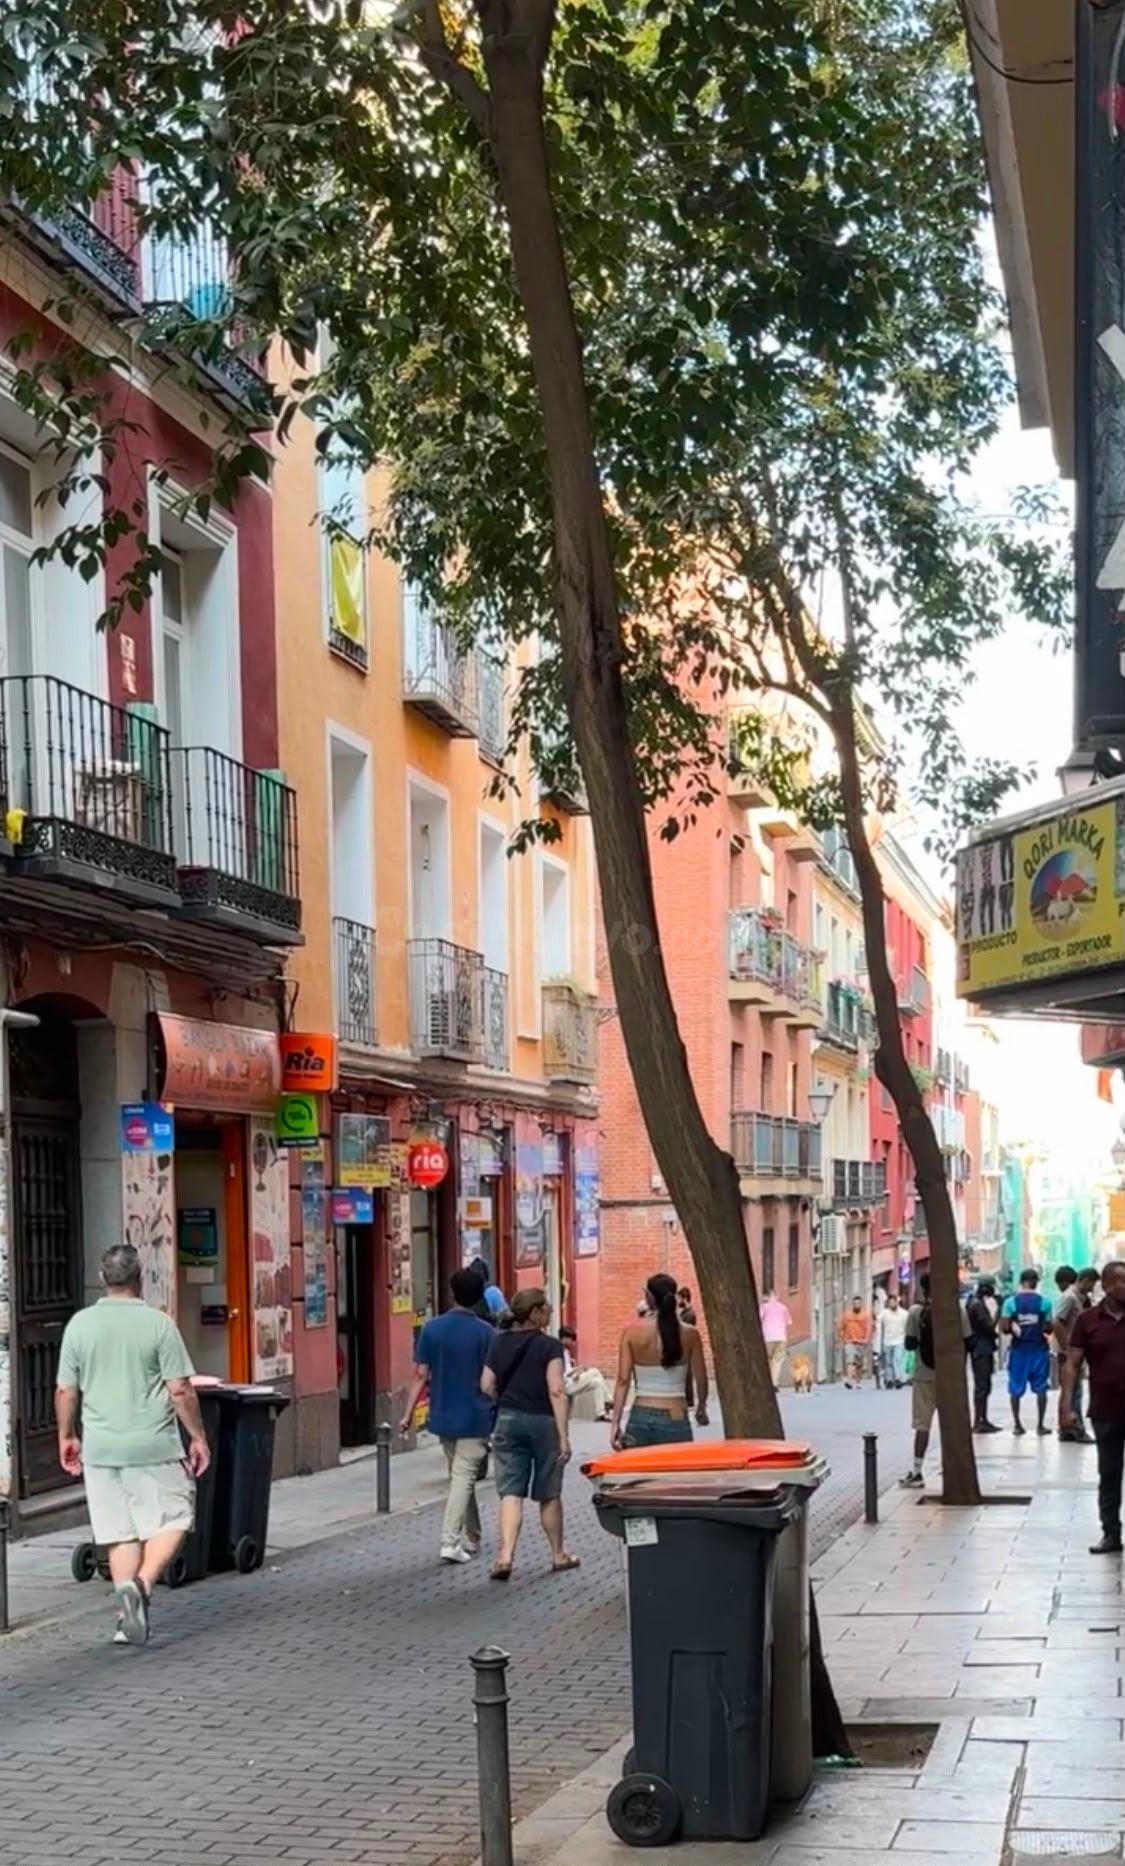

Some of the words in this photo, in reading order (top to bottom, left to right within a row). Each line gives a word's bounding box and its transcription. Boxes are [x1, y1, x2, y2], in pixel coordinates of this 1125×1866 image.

[1023, 826, 1054, 879] QORI
[1058, 816, 1105, 862] MARKA
[284, 1046, 325, 1071] Ria
[413, 1147, 444, 1170] ria
